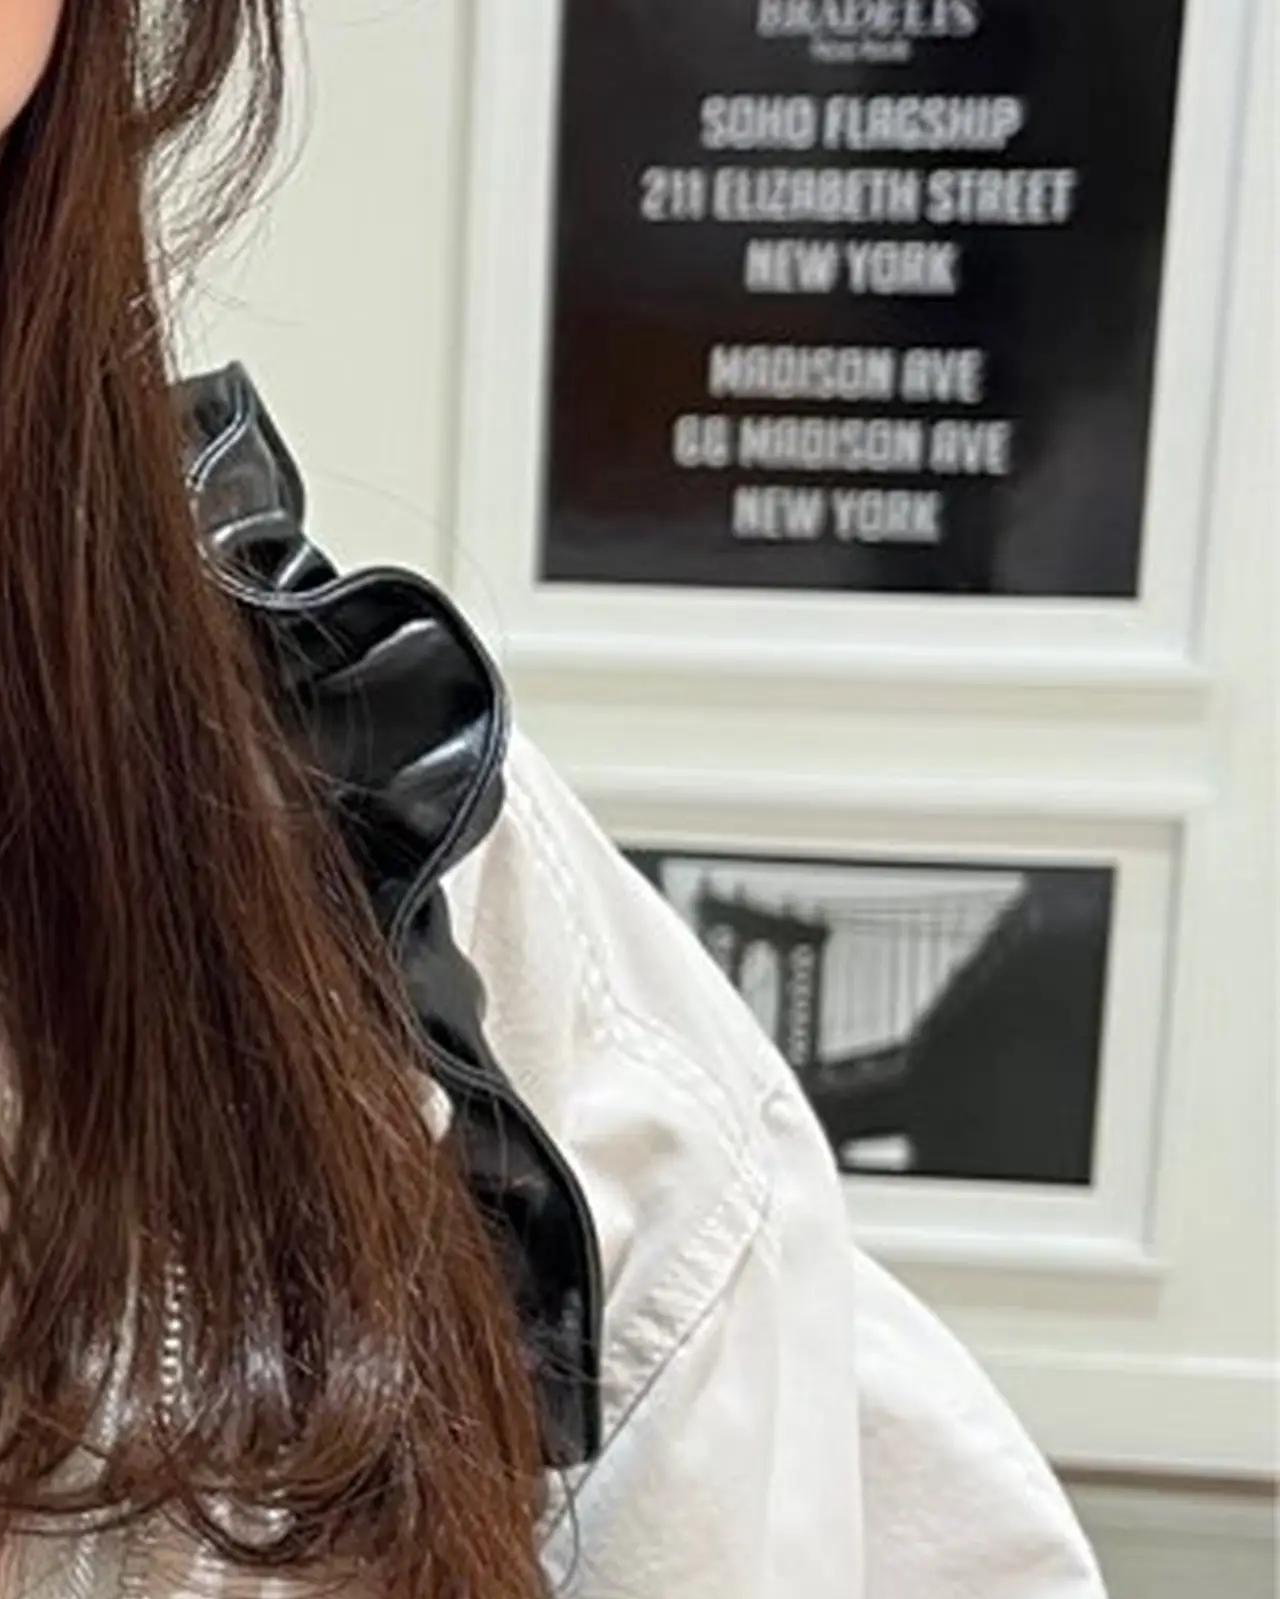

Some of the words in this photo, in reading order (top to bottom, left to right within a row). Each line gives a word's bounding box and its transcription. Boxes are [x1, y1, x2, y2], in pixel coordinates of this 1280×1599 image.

[702, 96, 817, 149] SOHO
[824, 96, 1021, 149] FLAGSHIP
[642, 168, 705, 220] 211
[713, 168, 919, 221] ELIZABETH
[928, 170, 1073, 223] STREET
[746, 240, 839, 292] NEW
[846, 242, 955, 293] YORK
[710, 346, 894, 398] MADISON
[902, 349, 979, 402] AVE
[739, 418, 923, 470] MADISON
[930, 421, 1007, 473] AVE
[734, 487, 824, 537] NEW
[833, 491, 938, 541] YORK
